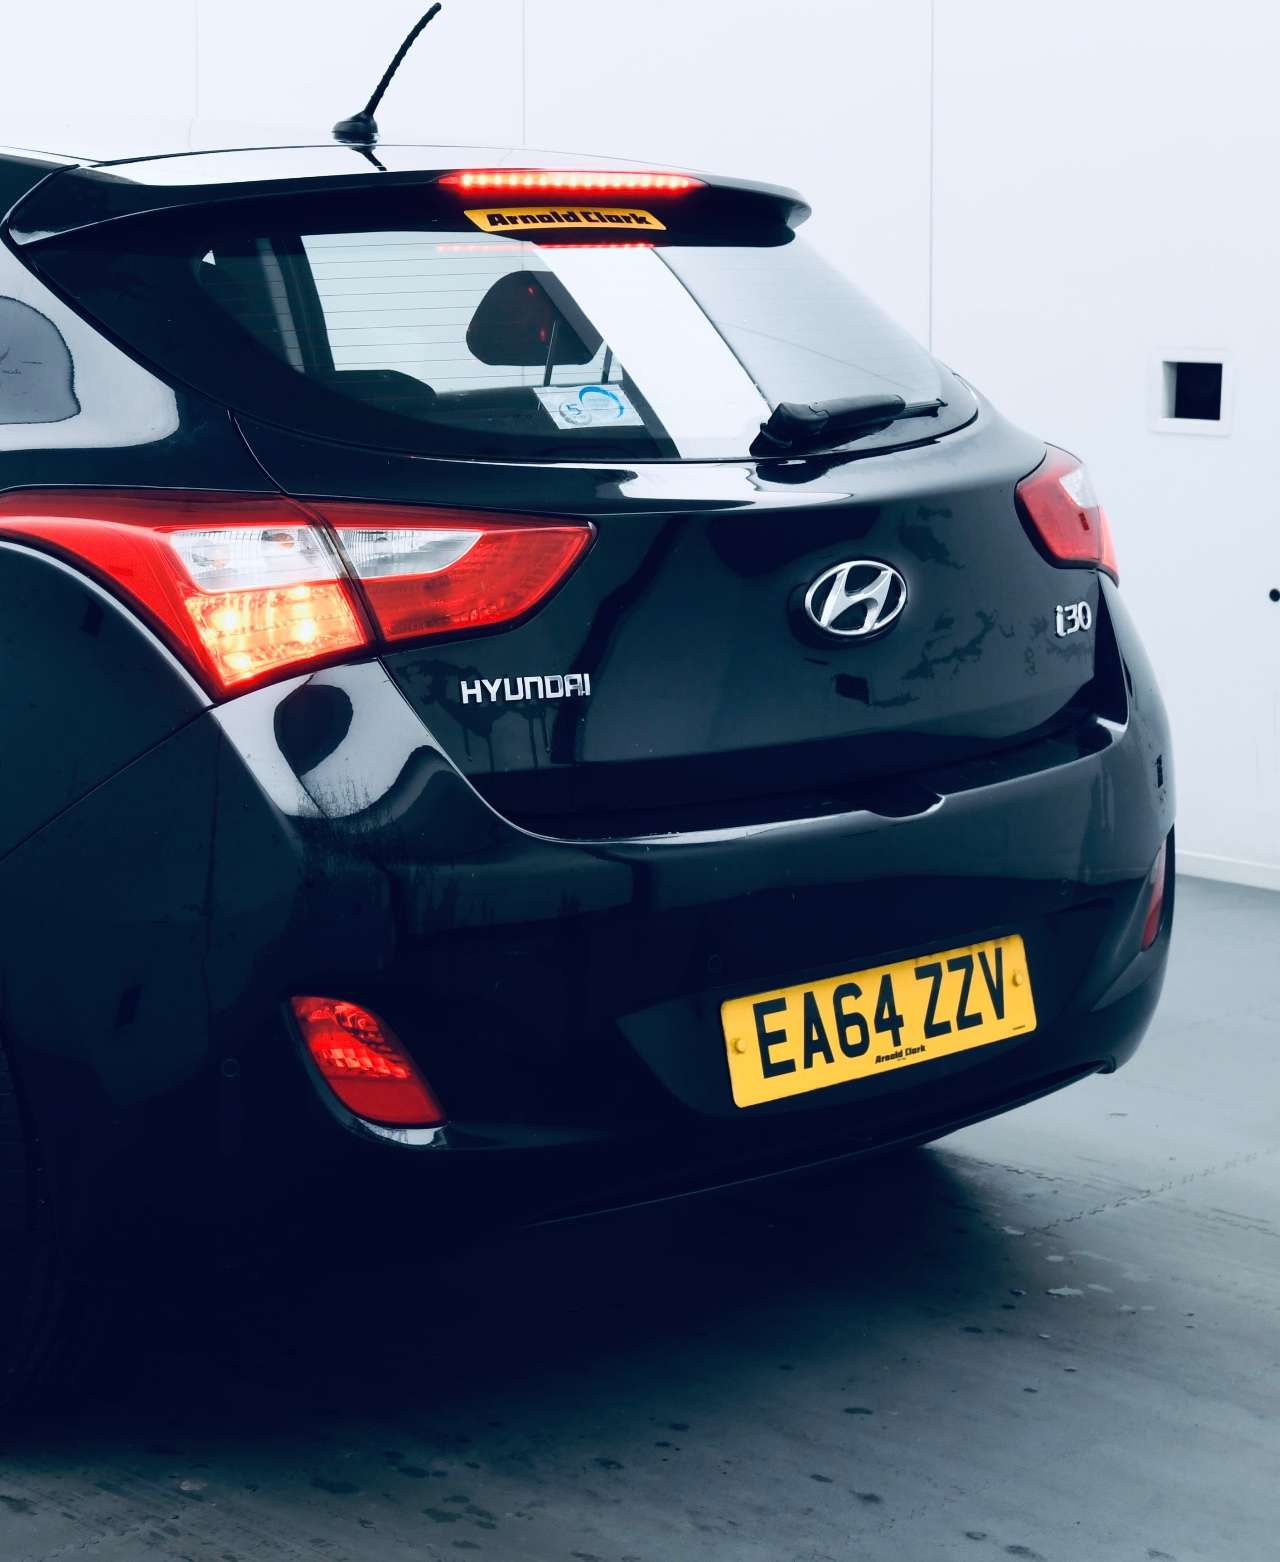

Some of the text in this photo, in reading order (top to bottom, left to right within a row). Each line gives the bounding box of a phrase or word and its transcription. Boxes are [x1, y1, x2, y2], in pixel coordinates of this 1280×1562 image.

[486, 211, 652, 226] Arnold Clark
[1056, 601, 1092, 637] i30
[460, 673, 591, 704] HYUNDAI
[753, 946, 1005, 1079] EA64 ZZV
[875, 1044, 926, 1064] Arnold Clark
